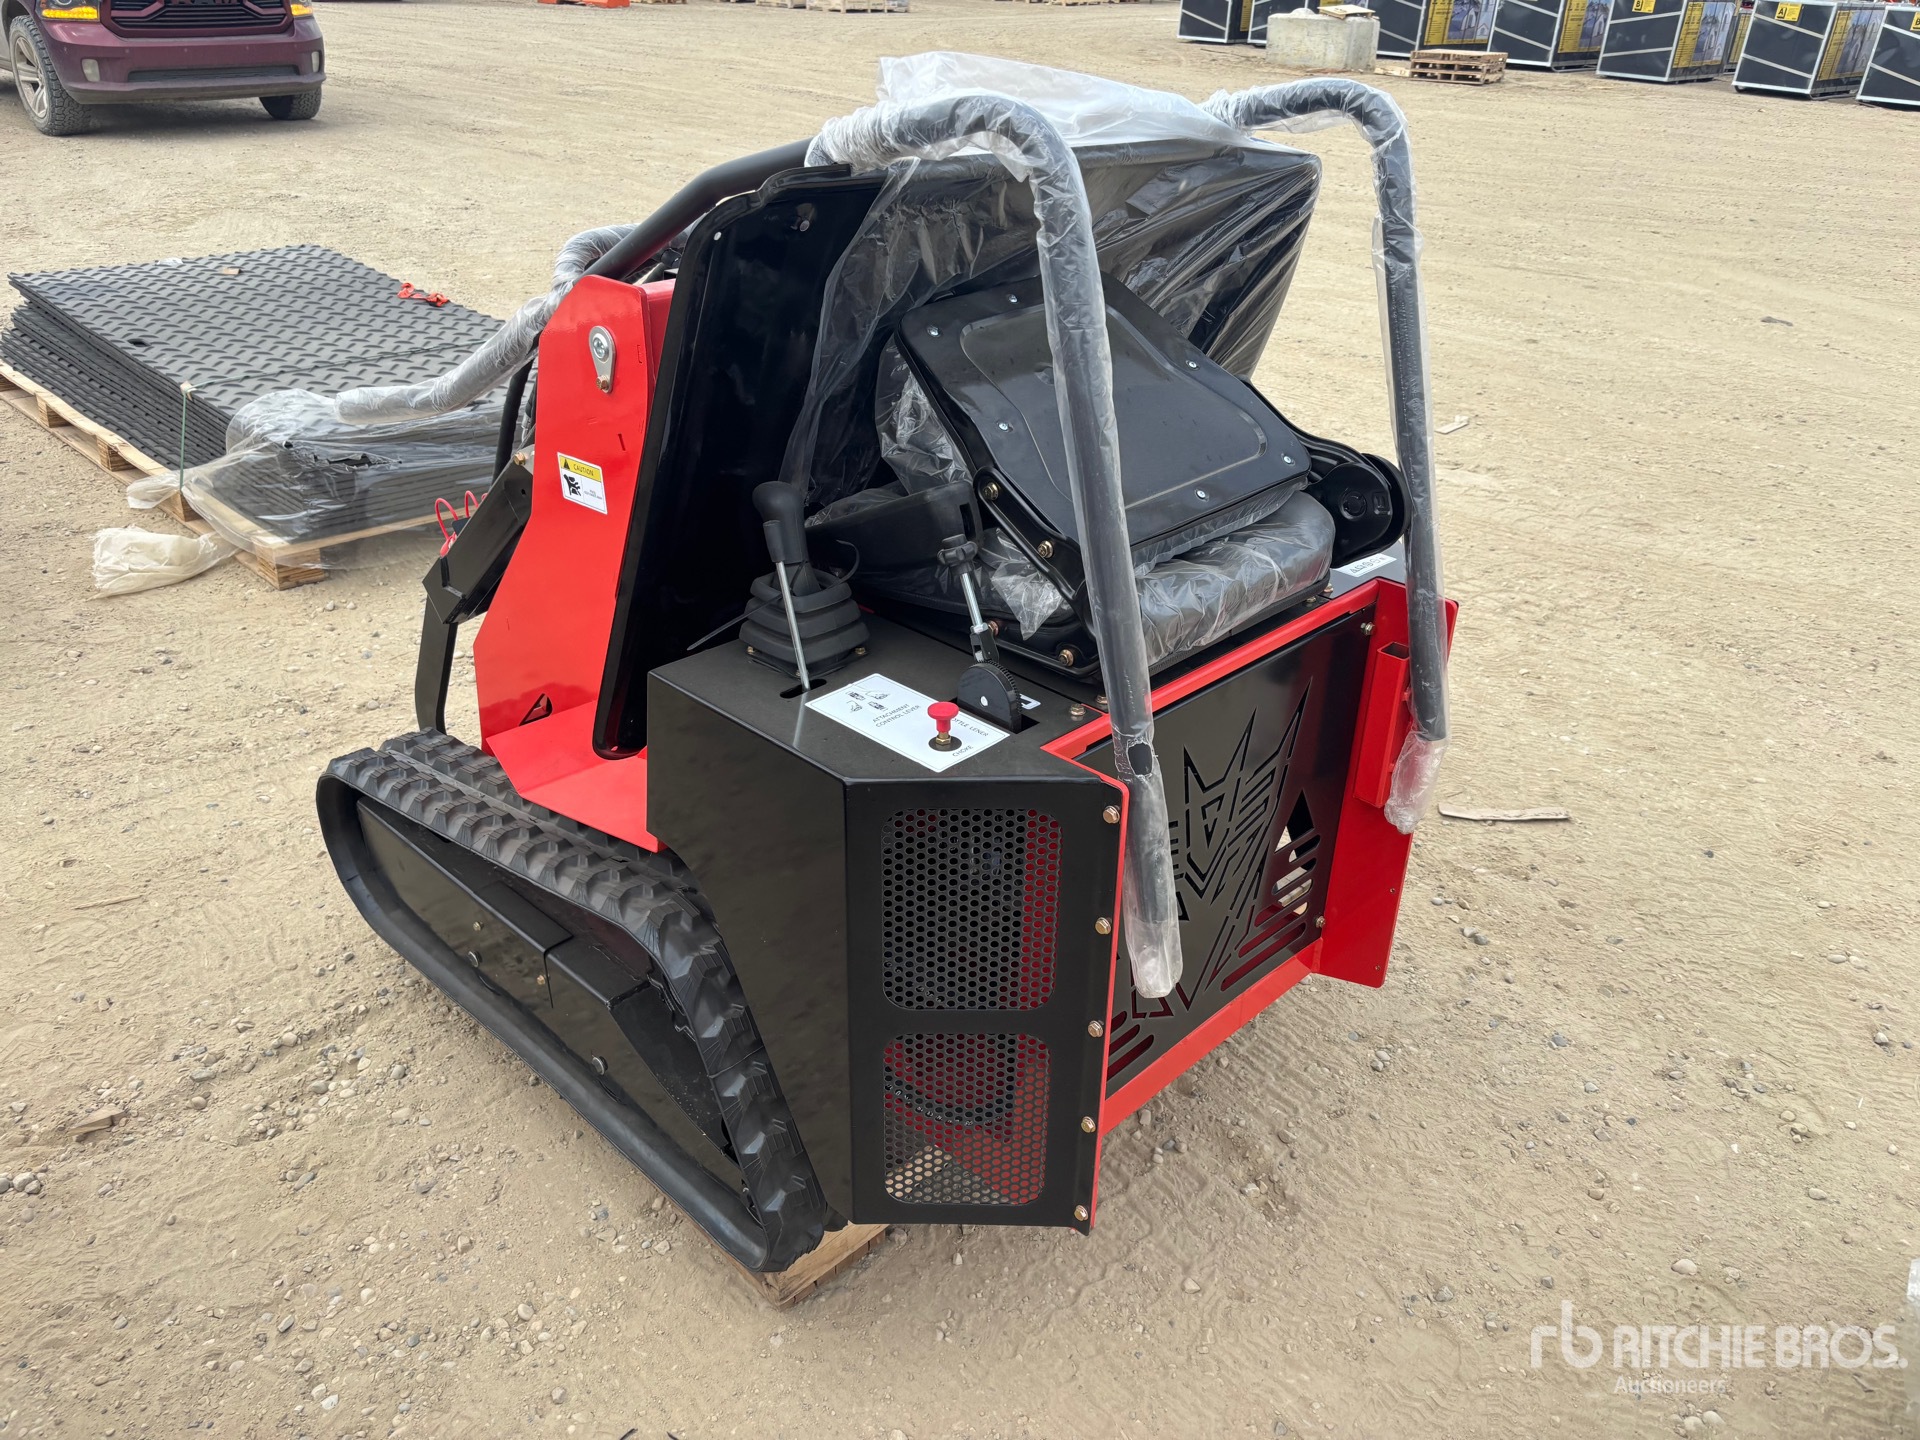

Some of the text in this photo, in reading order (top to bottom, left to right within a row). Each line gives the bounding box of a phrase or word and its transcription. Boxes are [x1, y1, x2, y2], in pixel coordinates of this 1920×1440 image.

[574, 464, 594, 476] CAUTION
[872, 703, 910, 723] ATTACHMENT
[875, 704, 921, 728] CONTROL LEVER
[952, 745, 973, 757] CHOKE
